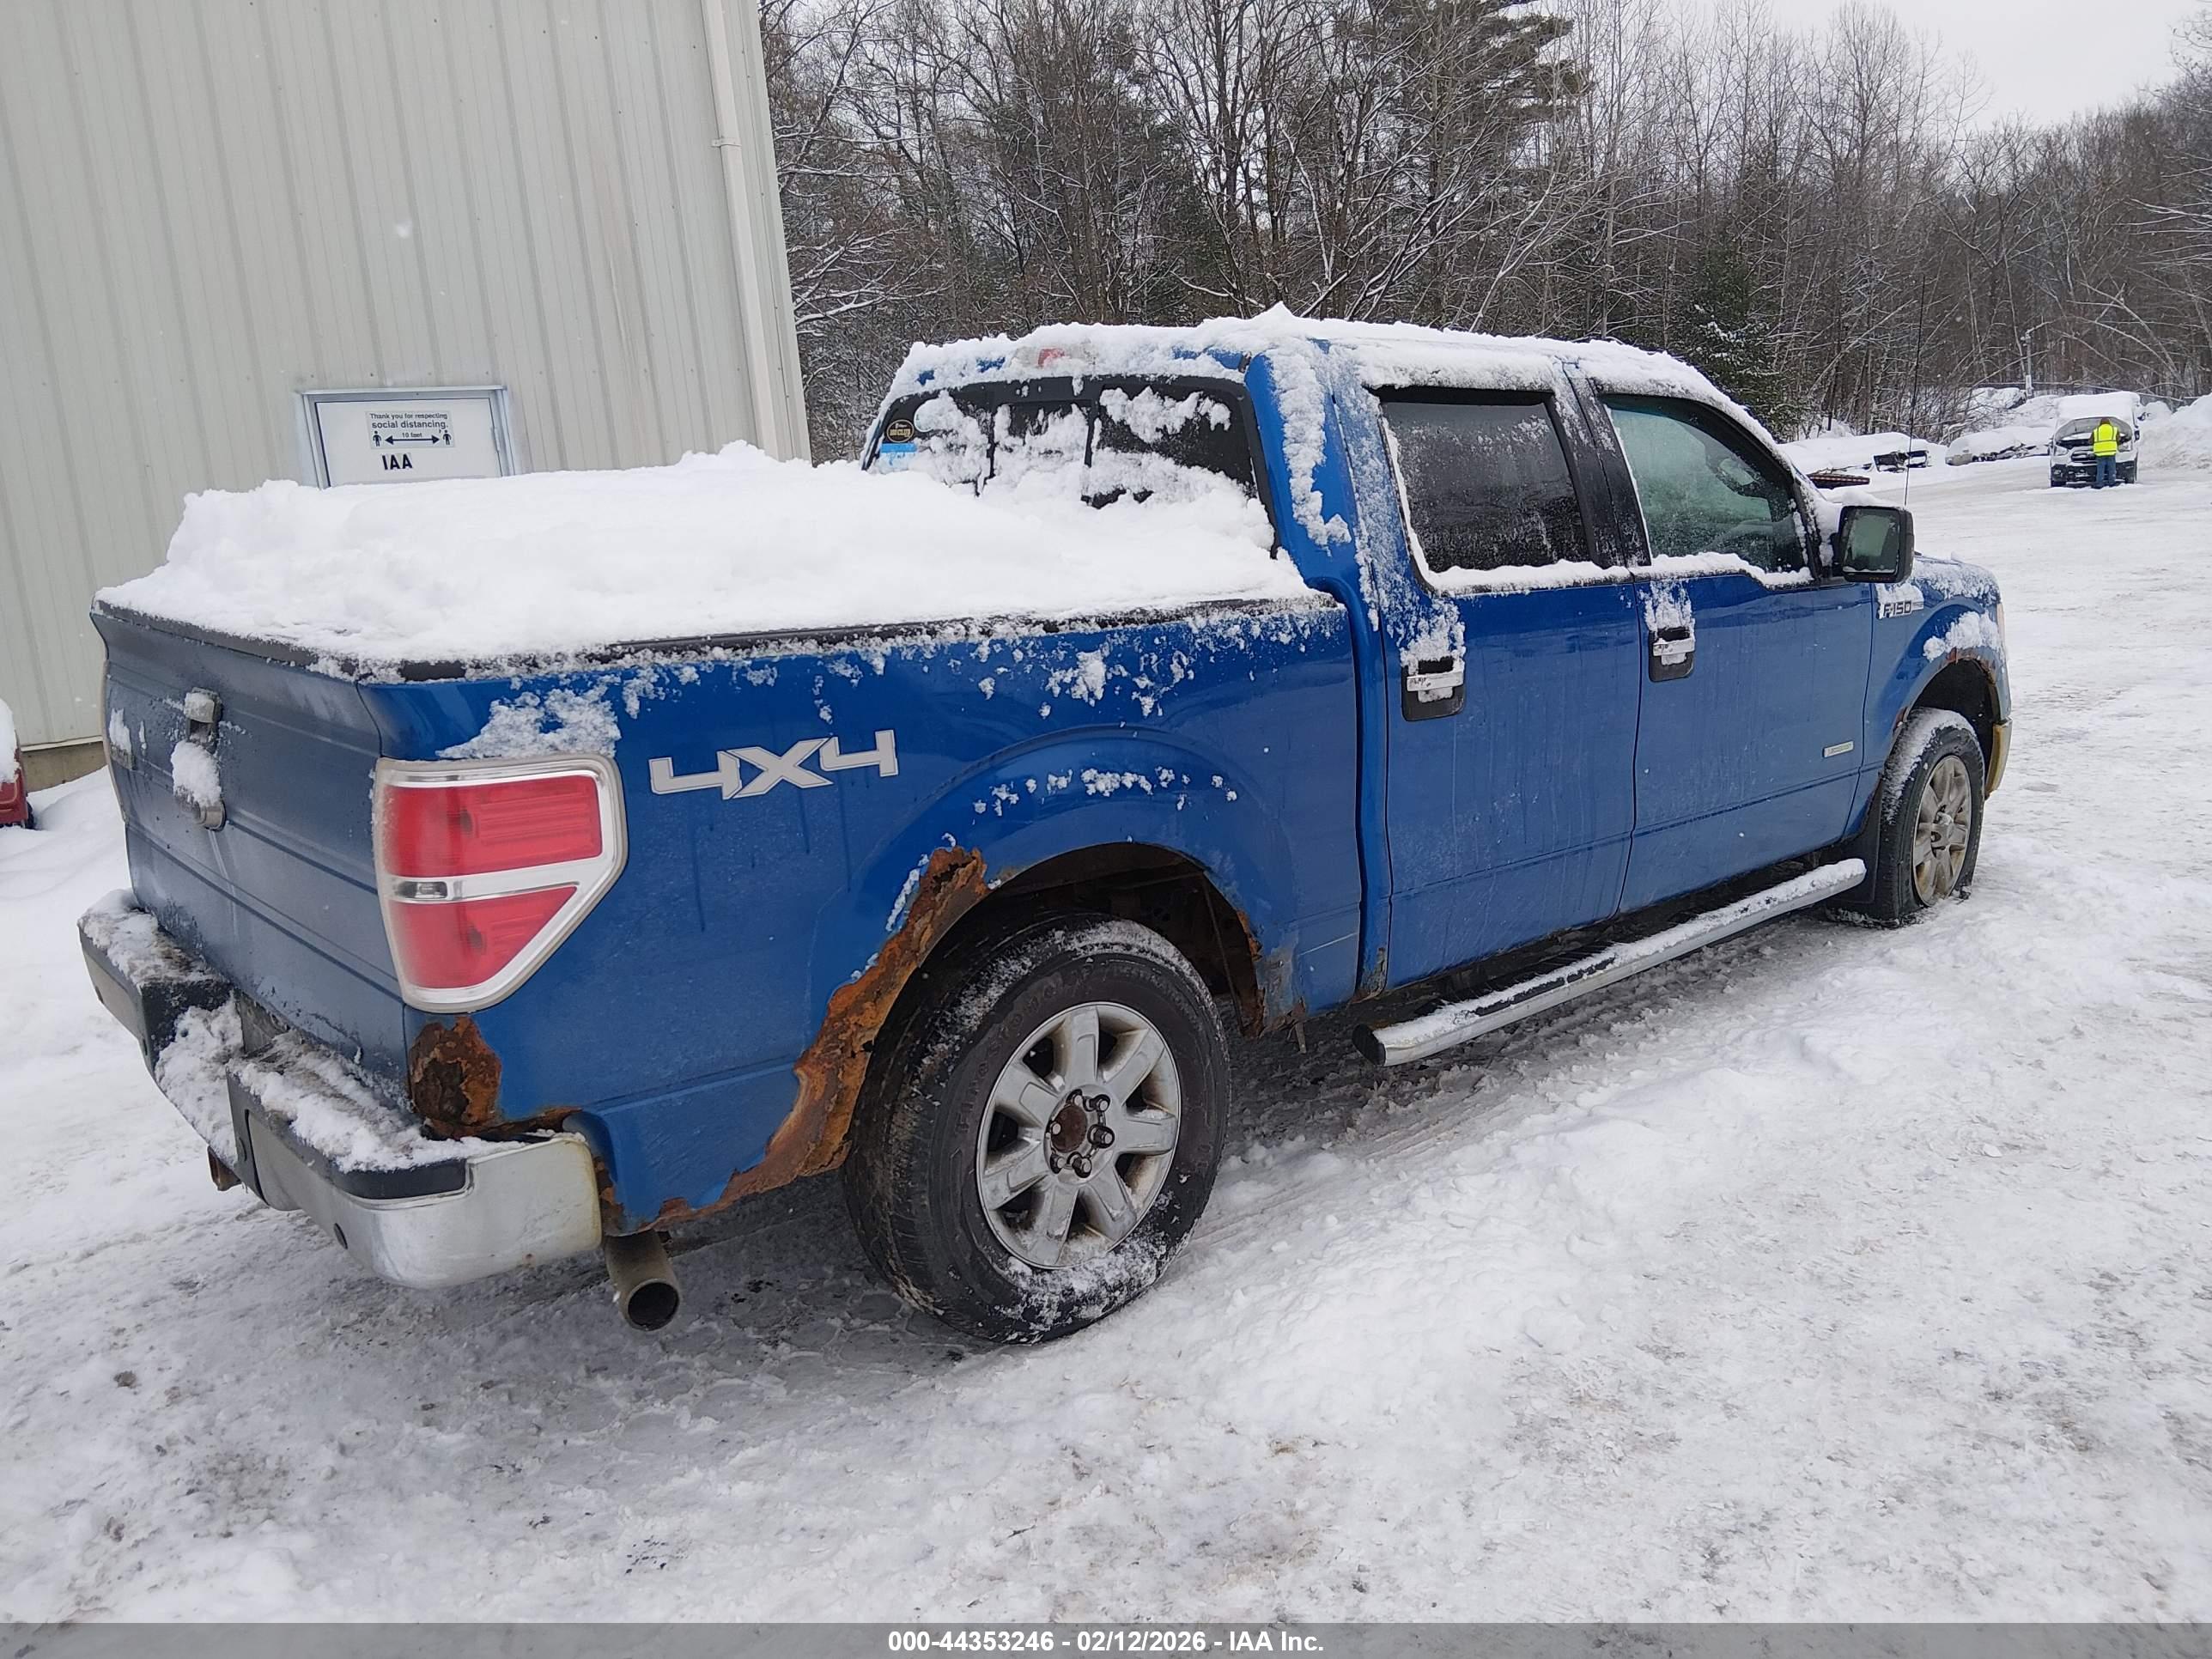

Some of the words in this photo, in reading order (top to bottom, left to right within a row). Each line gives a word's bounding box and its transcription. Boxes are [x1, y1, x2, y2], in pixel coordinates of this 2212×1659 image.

[372, 420, 398, 428] social
[400, 420, 448, 429] distancing.
[381, 453, 413, 471] IAA
